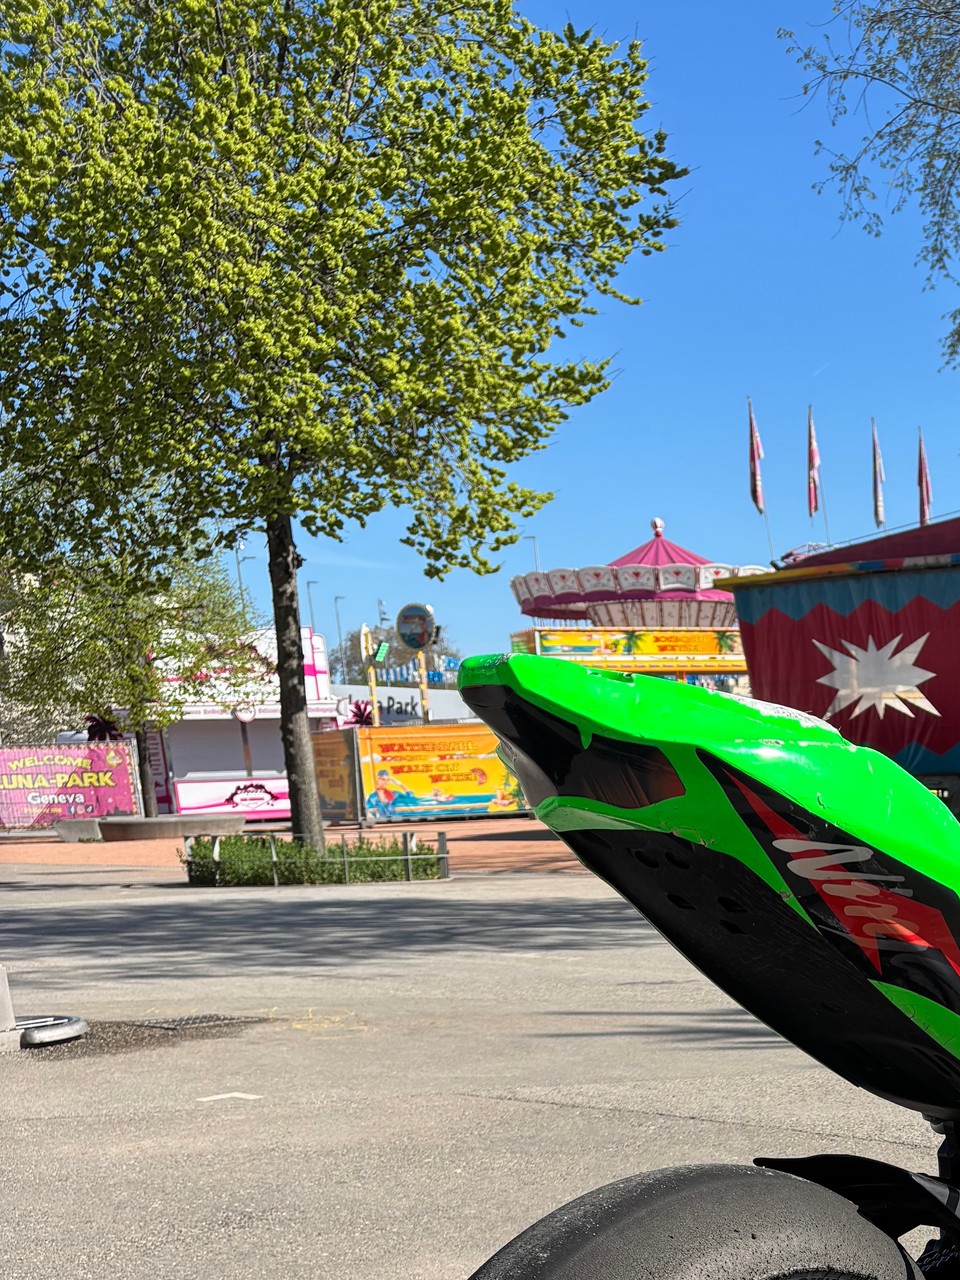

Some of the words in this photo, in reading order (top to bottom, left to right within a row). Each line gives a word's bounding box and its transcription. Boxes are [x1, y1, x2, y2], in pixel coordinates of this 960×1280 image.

[386, 696, 419, 716] Park
[7, 755, 92, 771] WELCOME
[27, 791, 85, 804] Geneva
